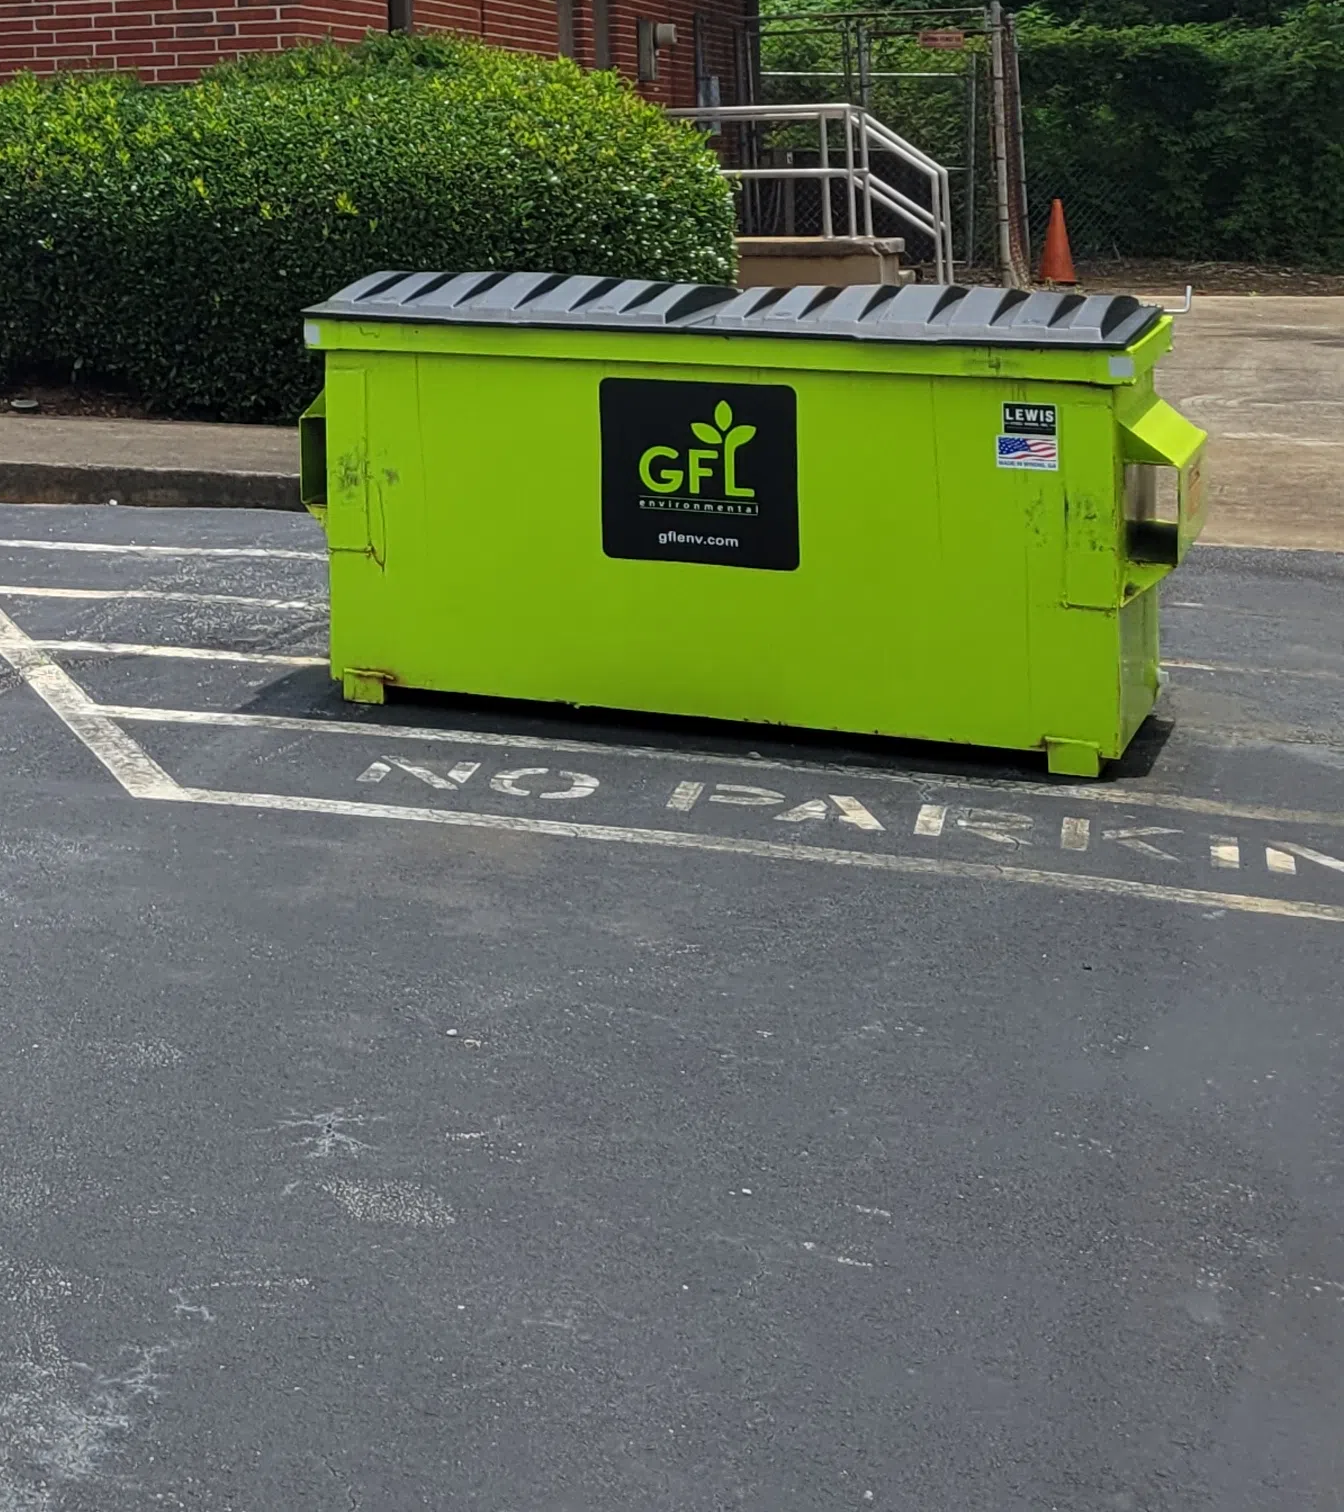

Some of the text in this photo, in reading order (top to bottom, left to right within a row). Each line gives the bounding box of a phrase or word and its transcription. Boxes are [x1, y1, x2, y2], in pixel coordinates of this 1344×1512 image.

[1005, 408, 1054, 422] LEWIS
[639, 425, 756, 497] GFL
[639, 498, 759, 515] environmental
[658, 530, 739, 547] gflenv.com
[355, 754, 601, 800] NO
